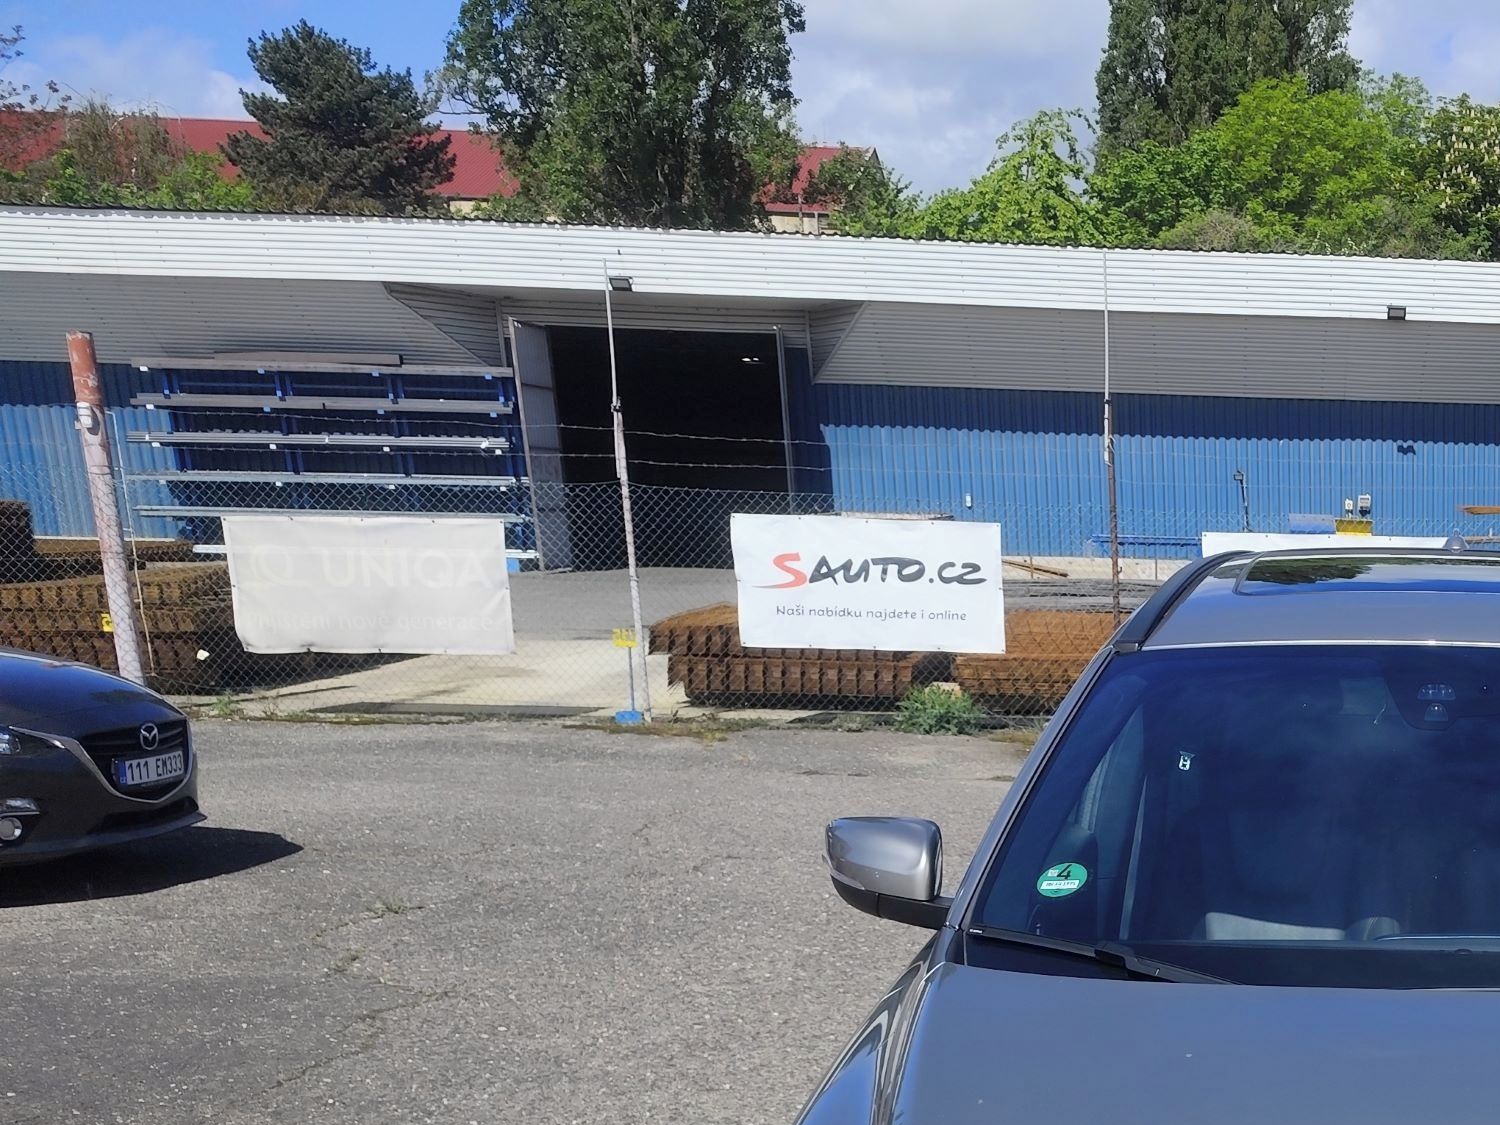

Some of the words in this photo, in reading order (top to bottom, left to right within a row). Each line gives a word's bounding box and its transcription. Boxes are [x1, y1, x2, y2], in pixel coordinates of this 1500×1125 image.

[321, 546, 493, 589] UNIQA
[776, 604, 805, 616] Naši
[808, 605, 862, 618] nabídku
[866, 608, 917, 621] najdete
[928, 610, 967, 620] online
[127, 761, 150, 782] 111
[155, 753, 183, 777] EM333
[1056, 863, 1073, 880] 4
